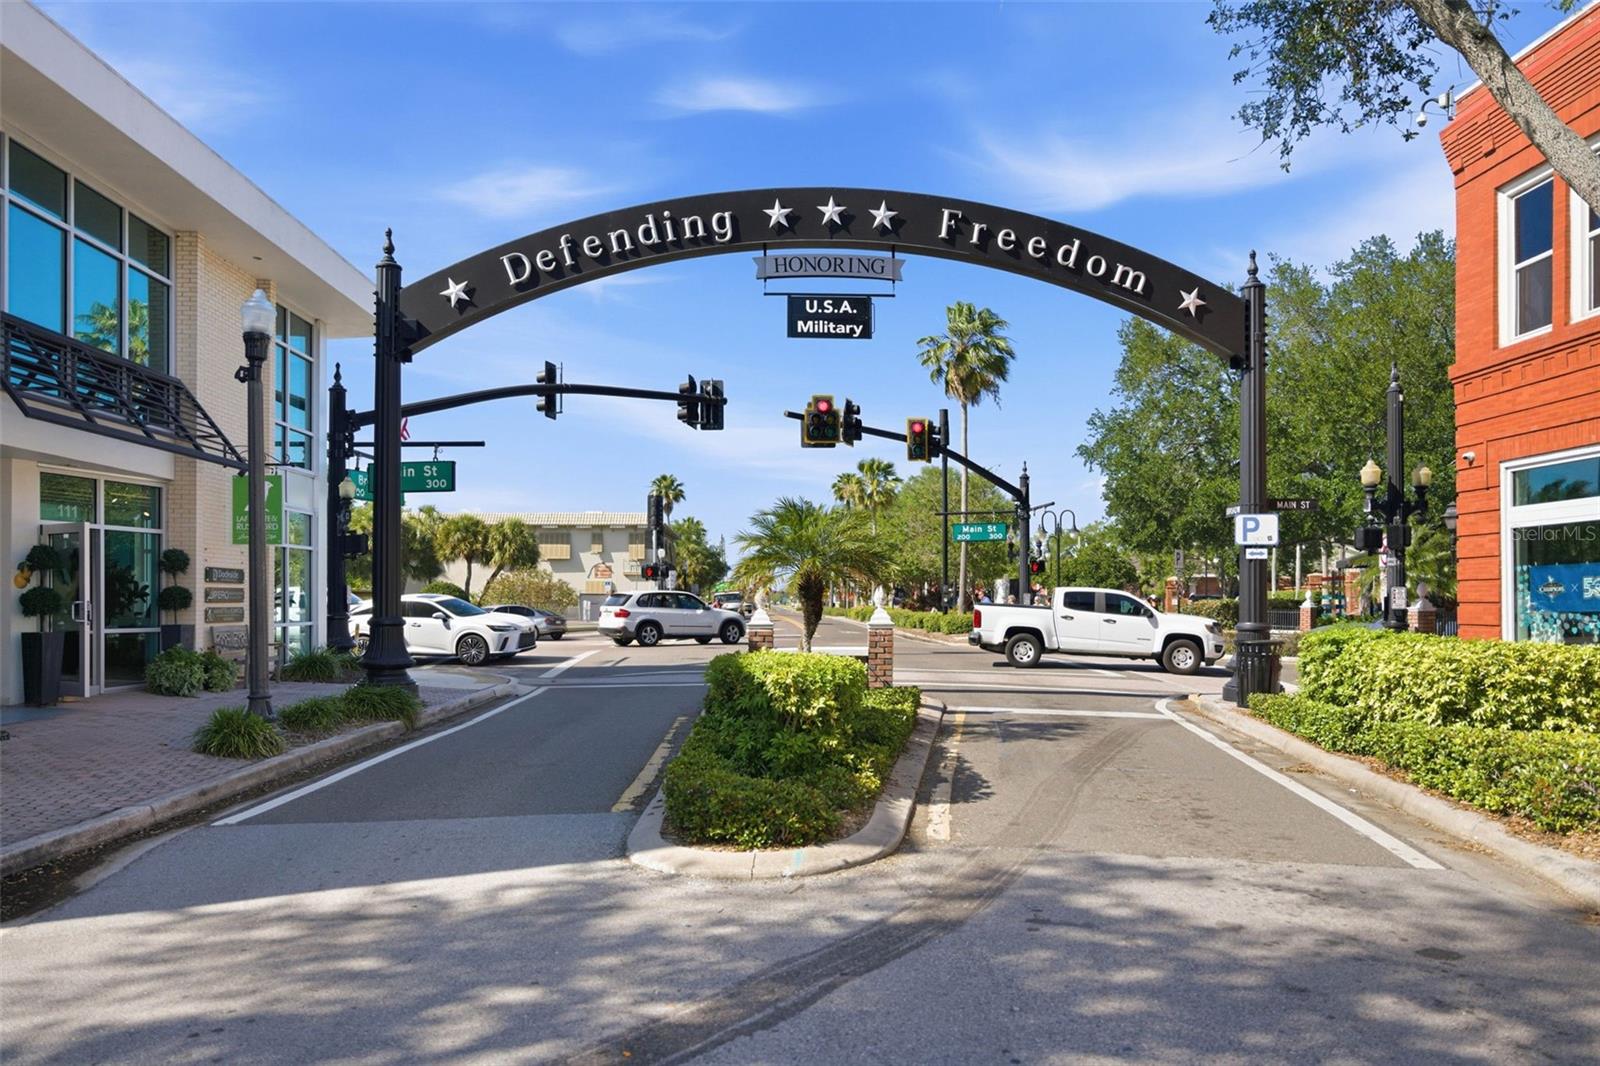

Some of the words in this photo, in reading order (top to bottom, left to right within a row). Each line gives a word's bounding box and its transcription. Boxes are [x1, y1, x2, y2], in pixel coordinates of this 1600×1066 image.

[500, 210, 733, 286] Defending
[938, 208, 1147, 295] Freedom
[774, 256, 885, 274] HONORING
[805, 299, 858, 314] U.S.A.
[797, 319, 864, 337] Military
[423, 465, 438, 477] St
[426, 479, 447, 489] 300
[57, 504, 78, 518] 111
[1276, 501, 1297, 510] MAIN
[1300, 501, 1311, 510] ST
[962, 525, 983, 534] Main
[987, 525, 997, 533] St
[1242, 516, 1261, 542] P
